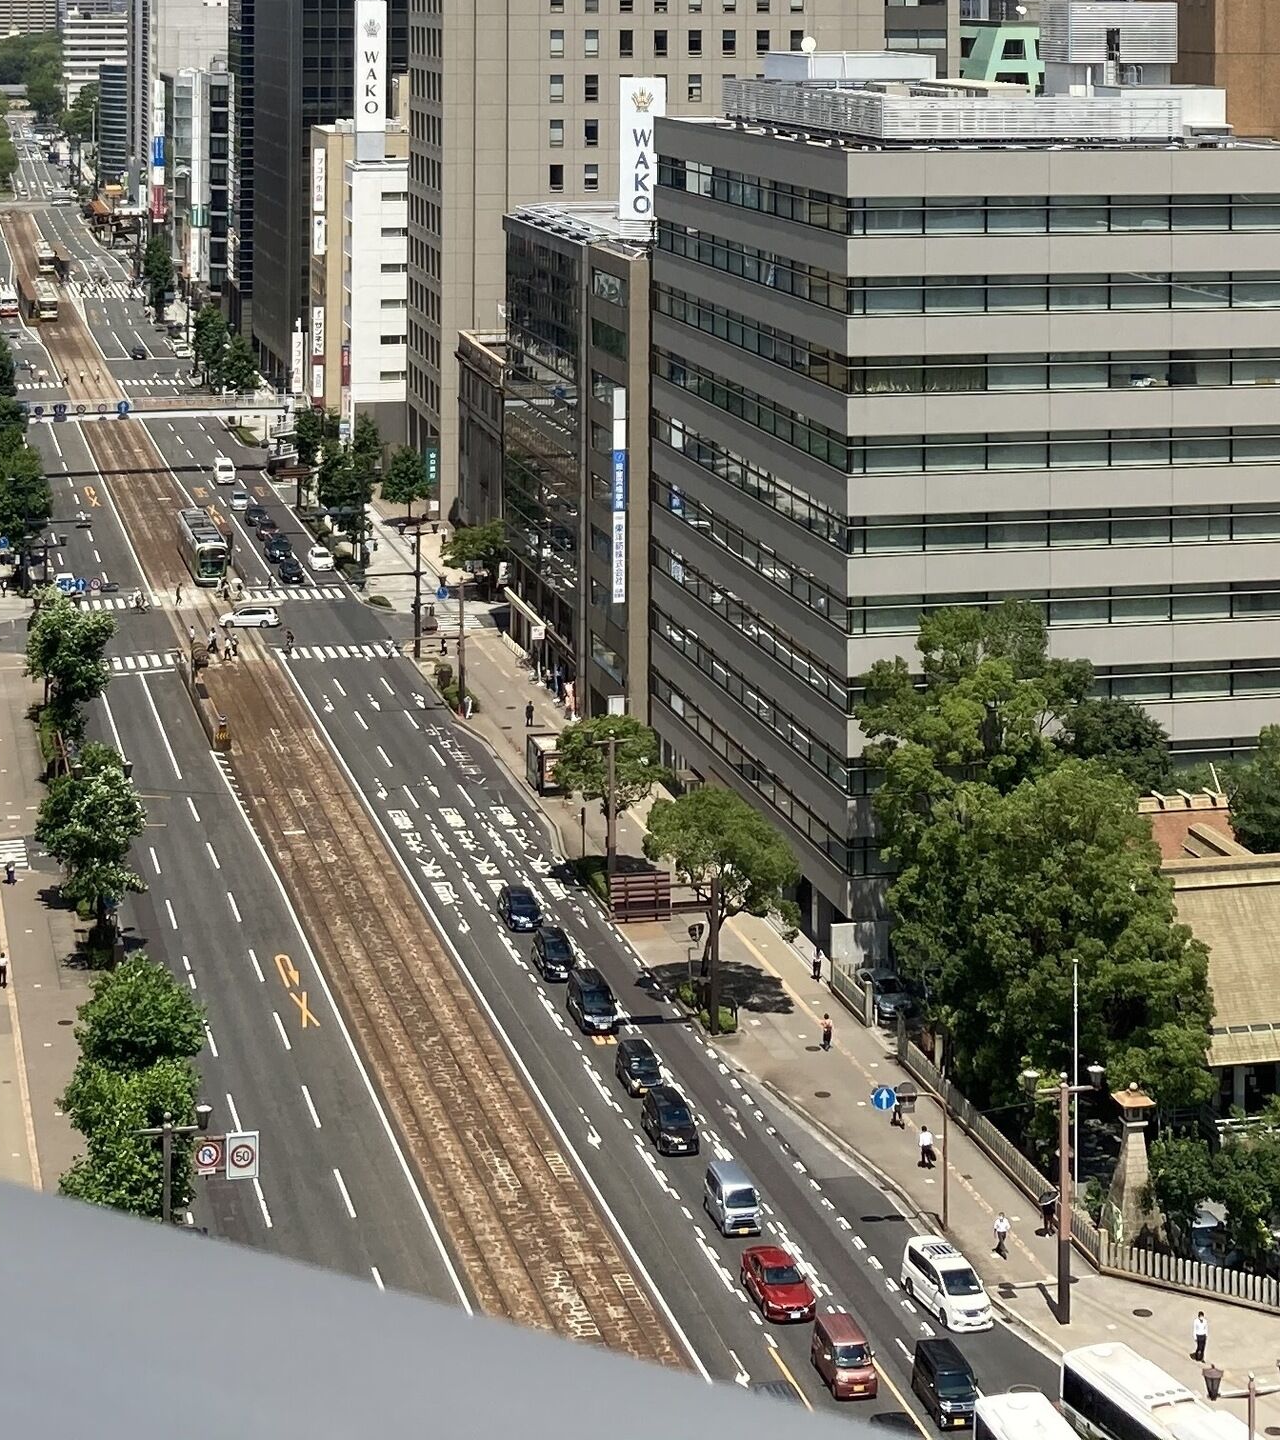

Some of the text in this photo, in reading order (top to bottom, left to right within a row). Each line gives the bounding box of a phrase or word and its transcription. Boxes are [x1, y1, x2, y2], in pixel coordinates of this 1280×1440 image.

[363, 50, 380, 115] WAKO
[632, 128, 653, 214] WAKO
[235, 1150, 250, 1162] 50
